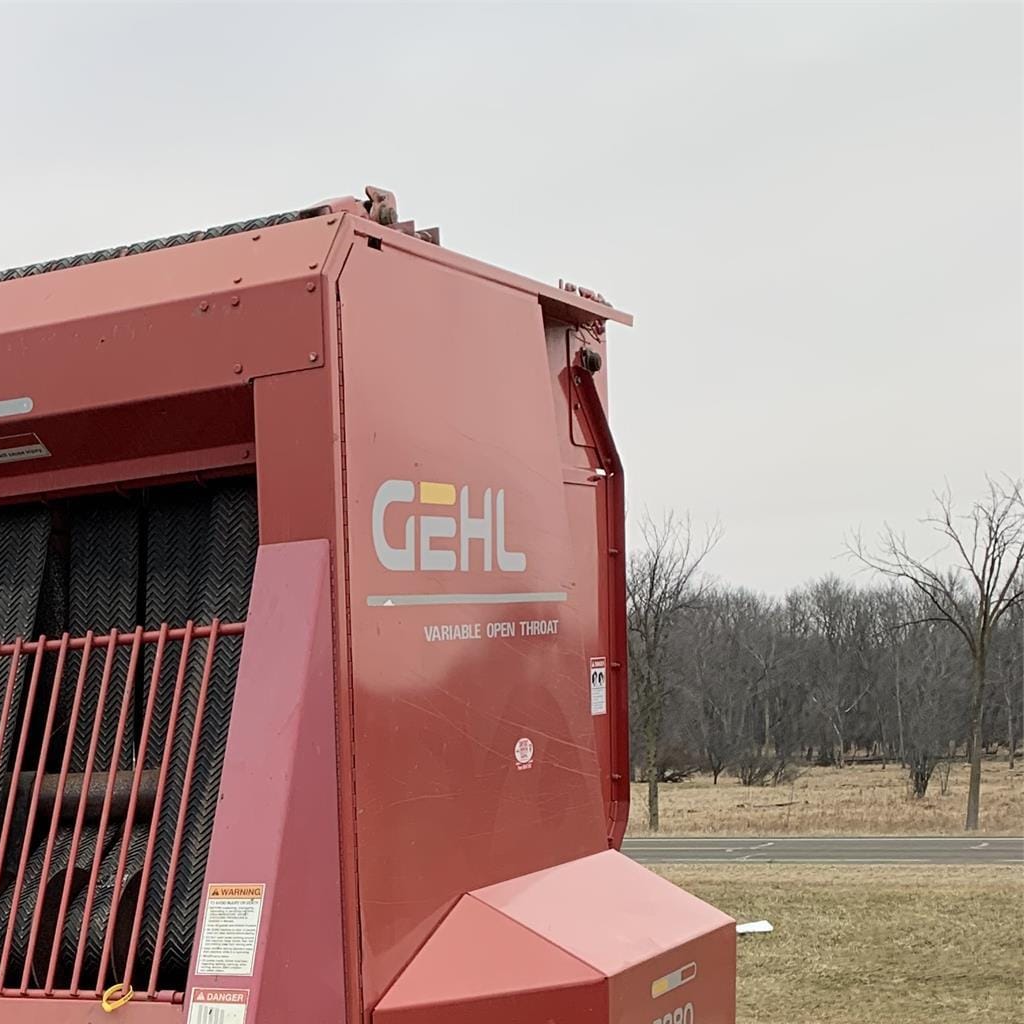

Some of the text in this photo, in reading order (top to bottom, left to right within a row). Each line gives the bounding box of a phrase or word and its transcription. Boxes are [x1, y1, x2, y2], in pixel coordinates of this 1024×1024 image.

[372, 479, 527, 572] GEHL
[423, 619, 559, 642] VARIABLE OPEN THROAT
[221, 888, 261, 896] WARNING
[207, 993, 244, 1002] DANGER
